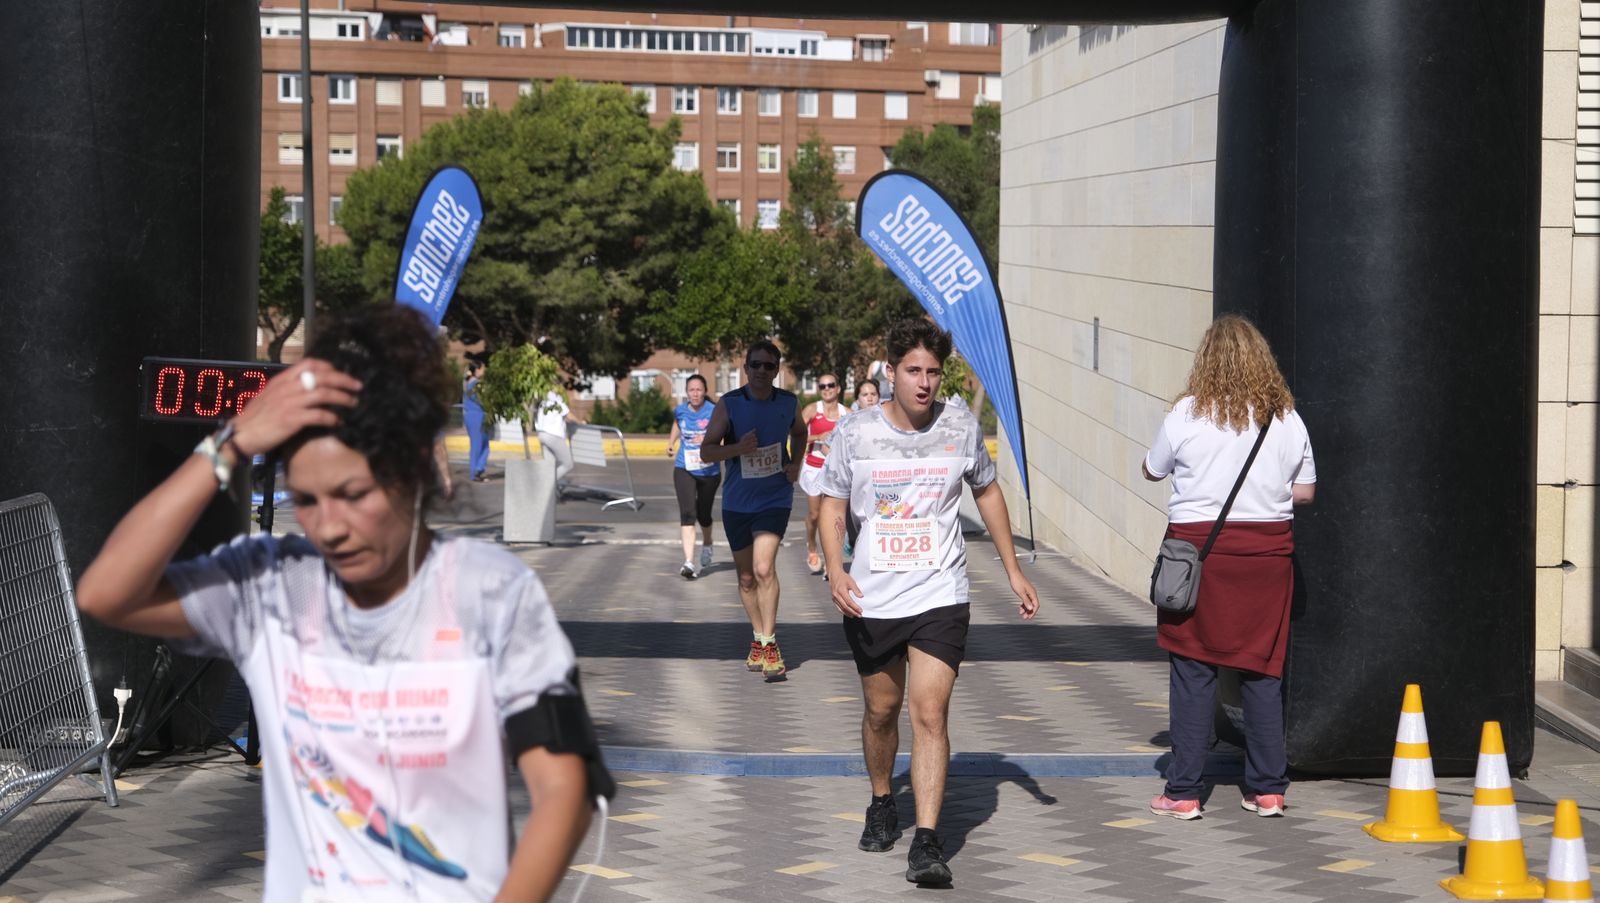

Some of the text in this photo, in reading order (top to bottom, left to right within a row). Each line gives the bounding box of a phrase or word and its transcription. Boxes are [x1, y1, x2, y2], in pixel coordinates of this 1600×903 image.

[747, 455, 778, 467] 1102
[877, 535, 932, 553] 1028
[396, 688, 449, 708] HUMO
